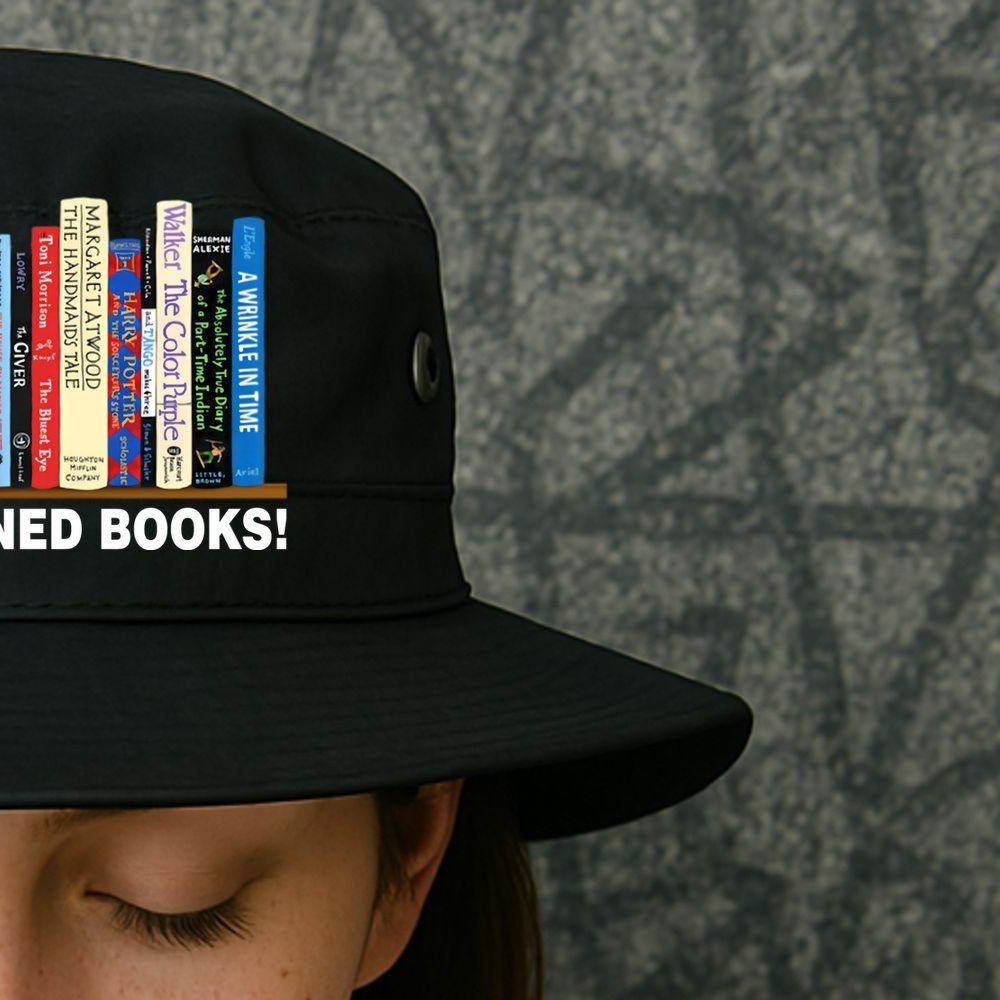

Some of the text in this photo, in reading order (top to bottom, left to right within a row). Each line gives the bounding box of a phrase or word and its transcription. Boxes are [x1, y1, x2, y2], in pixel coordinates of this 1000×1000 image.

[16, 252, 27, 291] LOWRY
[192, 245, 231, 254] ALEXIE
[38, 234, 53, 329] Toni Morrison
[64, 205, 80, 389] THE HANDMAID'S TALE
[85, 205, 102, 391] MARGARET ATWOOD
[197, 294, 210, 308] of
[144, 311, 154, 327] and
[158, 203, 187, 441] Walker The Color Purple
[213, 306, 227, 368] Absolutely
[13, 342, 29, 388] GIVER
[122, 292, 137, 427] HARRY POTTER
[143, 328, 155, 367] TANGO
[194, 321, 209, 382] Part-Time
[237, 271, 259, 433] A WRINKLE IN TIME
[143, 390, 154, 415] three
[214, 369, 227, 394] True
[35, 379, 52, 472] The Bluest Eye
[195, 384, 210, 431] Indian
[209, 396, 228, 432] Diary
[63, 456, 104, 464] HOUGHTON
[65, 474, 100, 482] COMPANY
[119, 436, 129, 486] SCHOLASTIC
[235, 467, 260, 476] Ariel
[100, 507, 288, 550] BOOKS!
